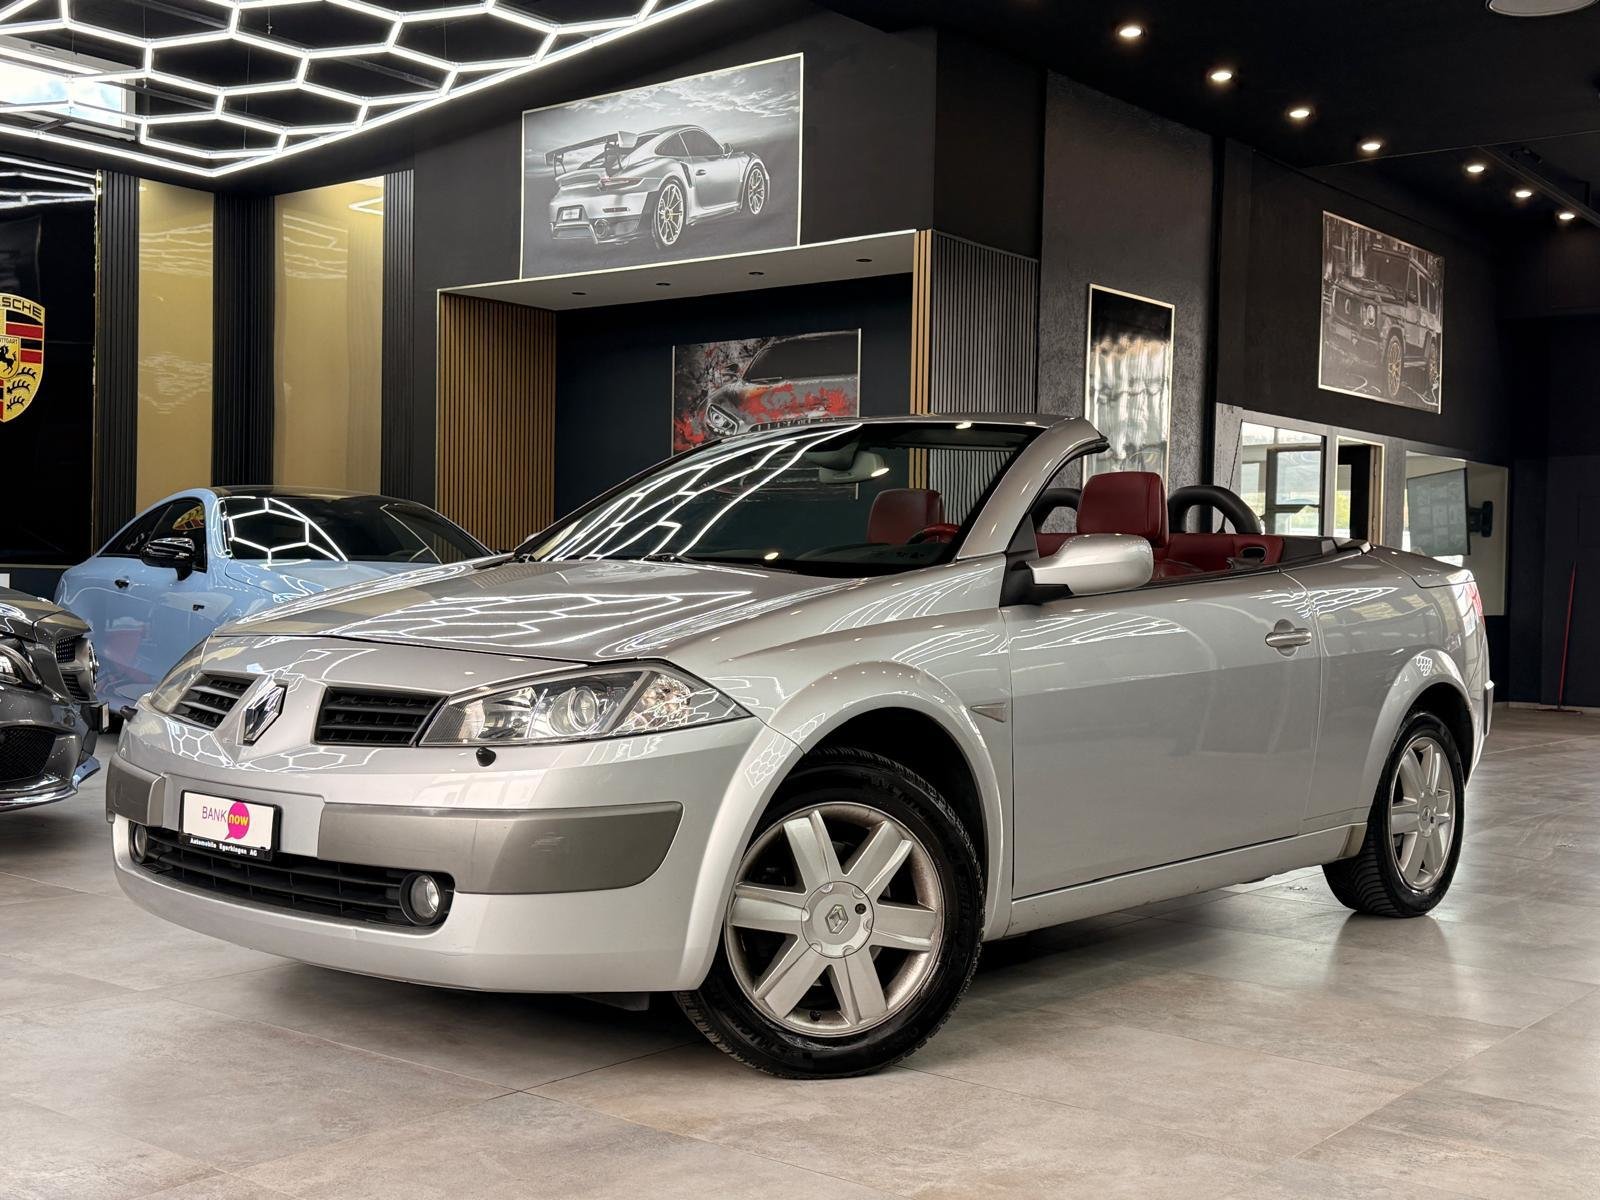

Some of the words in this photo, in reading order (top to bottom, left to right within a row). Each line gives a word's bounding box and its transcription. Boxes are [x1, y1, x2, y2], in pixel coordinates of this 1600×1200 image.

[201, 806, 227, 823] BANK
[228, 814, 249, 826] now
[190, 837, 217, 849] Automobile
[249, 849, 258, 857] AG
